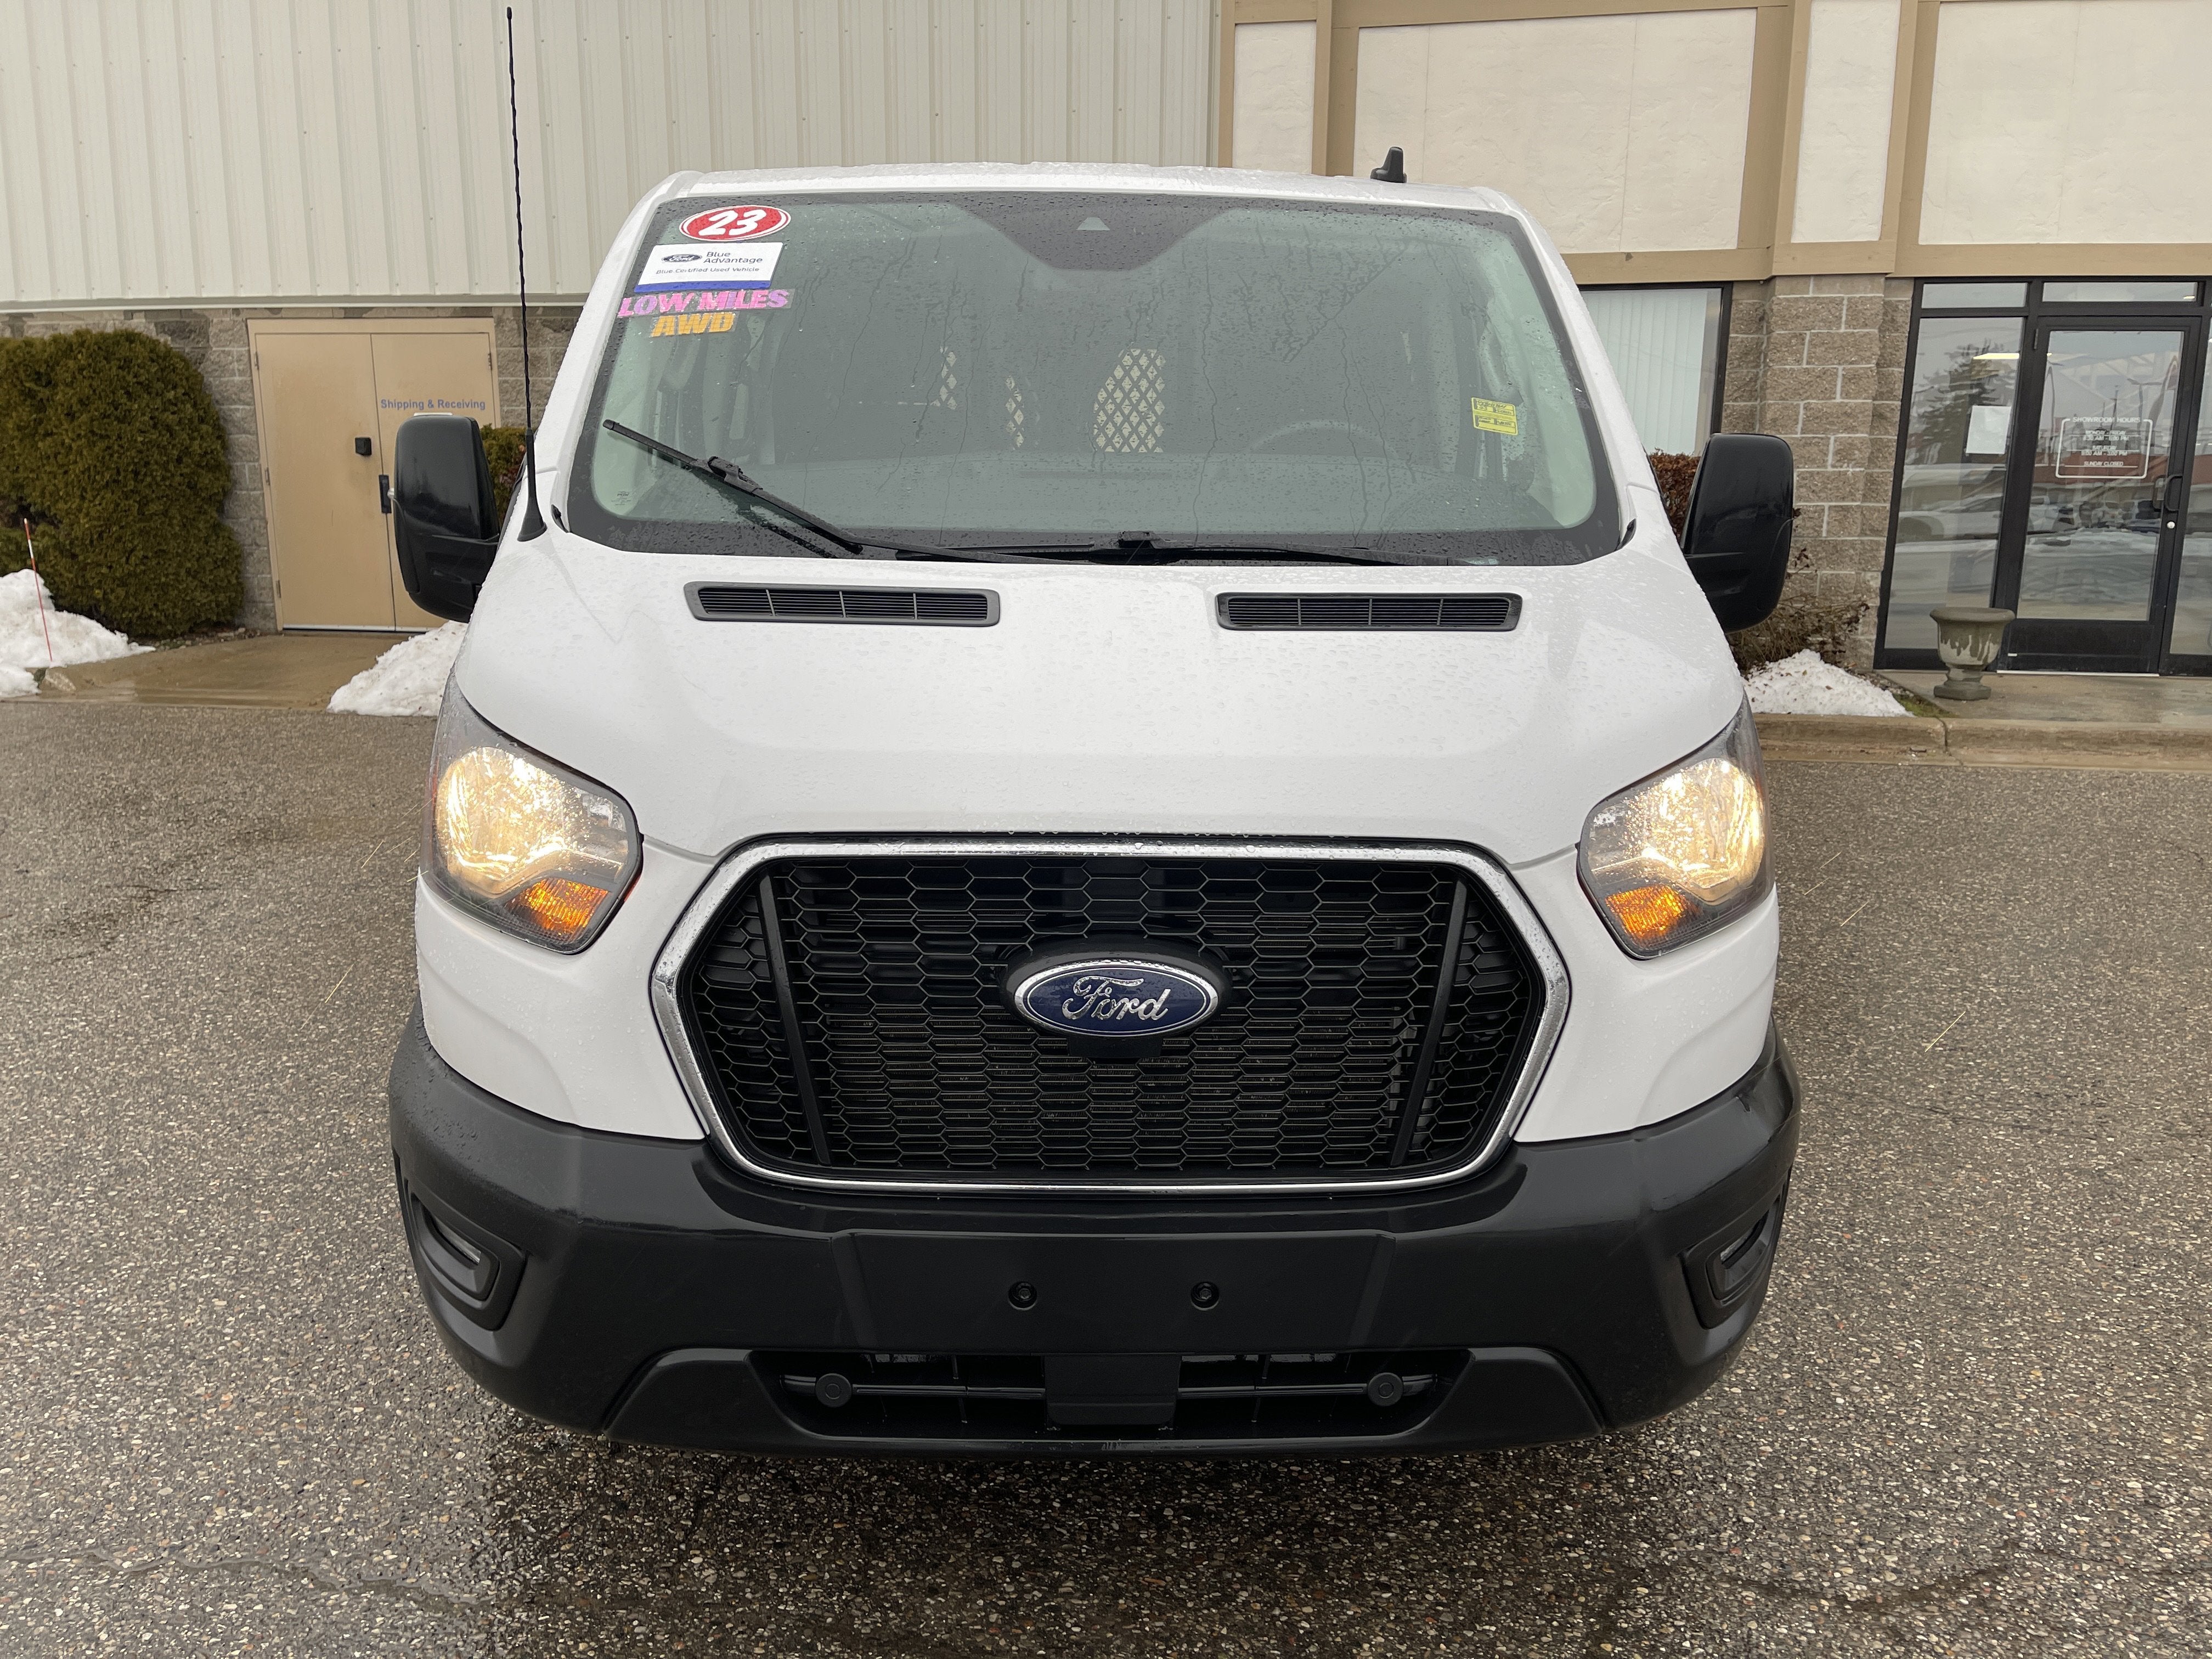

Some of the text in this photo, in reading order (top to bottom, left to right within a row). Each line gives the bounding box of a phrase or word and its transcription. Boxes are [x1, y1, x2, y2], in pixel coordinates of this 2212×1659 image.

[698, 209, 766, 236] 23
[617, 290, 789, 318] LOW MILES
[651, 312, 736, 337] AWD
[381, 399, 486, 410] Shipping & Receiving
[1062, 975, 1171, 1020] Ford
